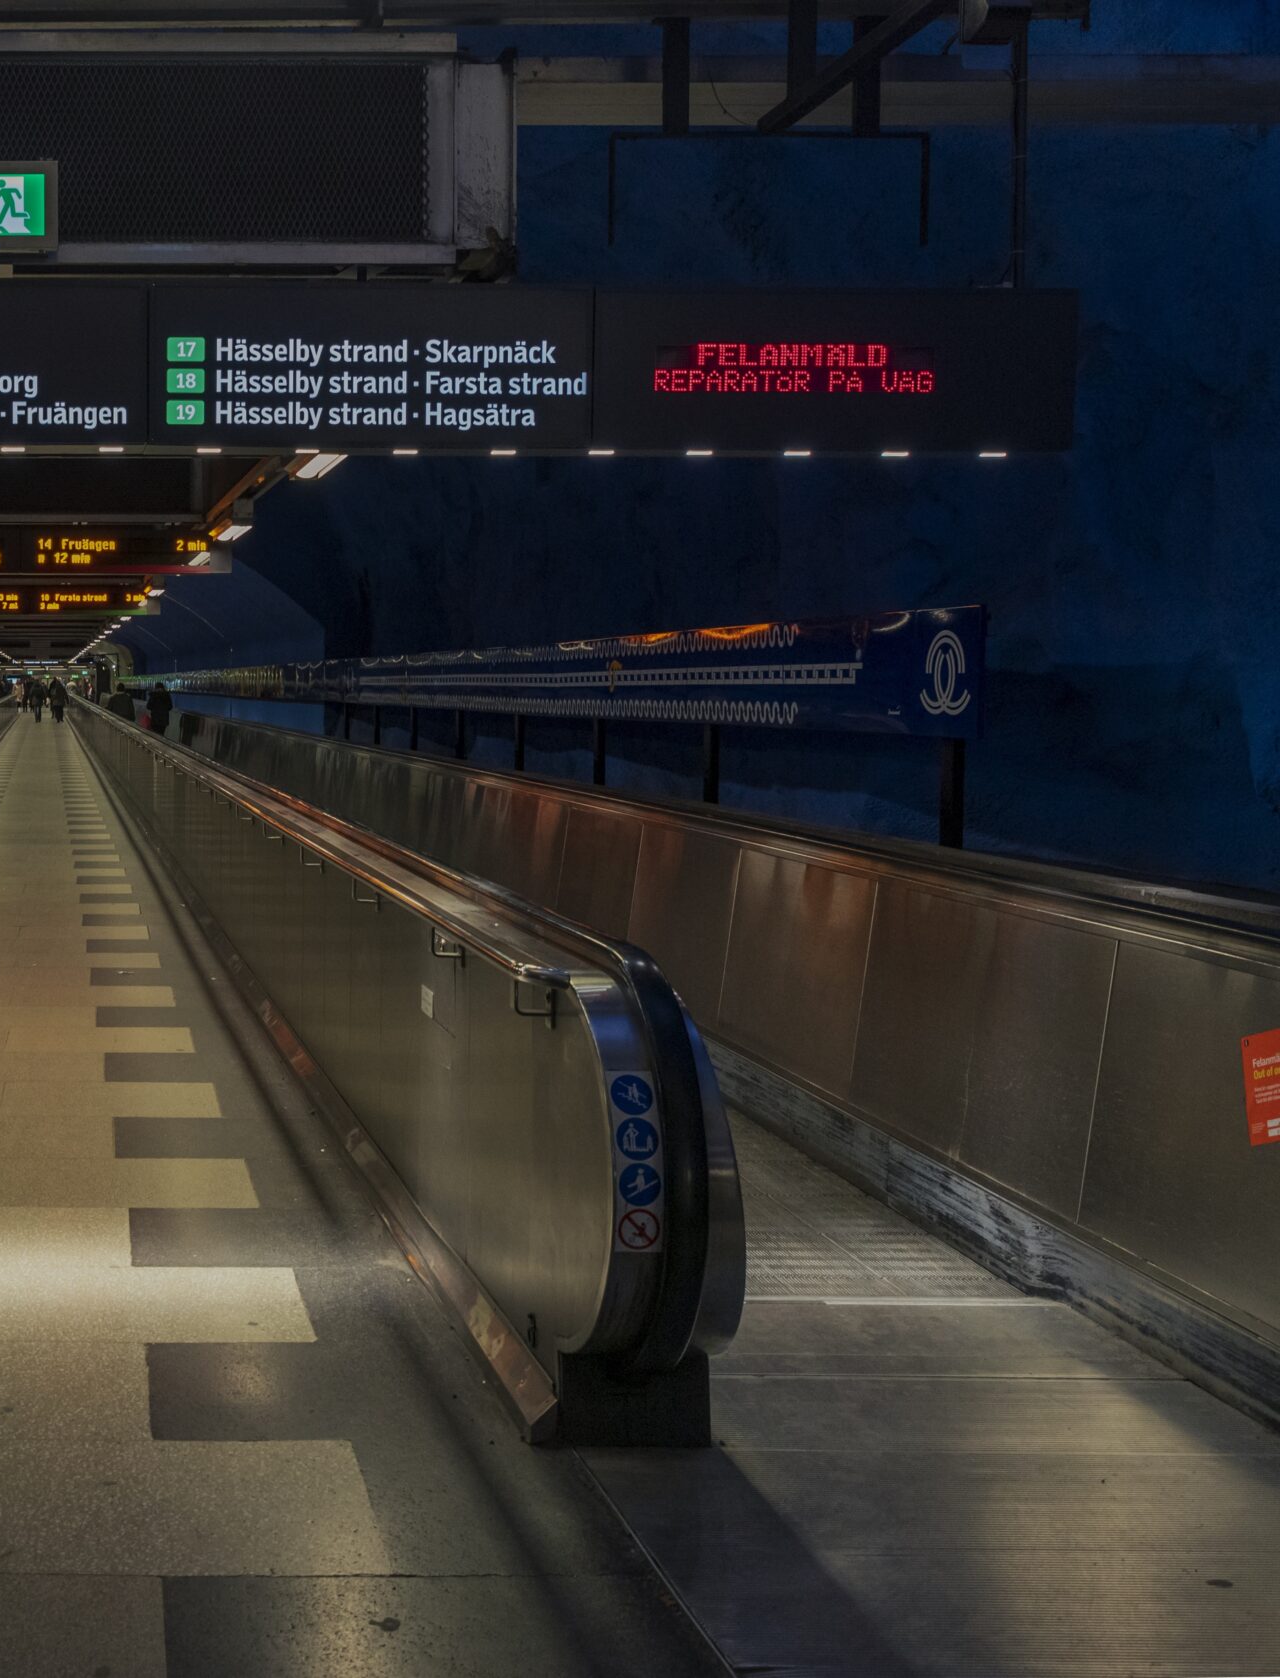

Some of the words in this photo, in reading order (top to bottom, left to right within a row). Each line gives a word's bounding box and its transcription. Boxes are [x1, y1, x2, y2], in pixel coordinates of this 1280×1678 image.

[177, 341, 196, 358] 17
[216, 338, 324, 368] Hässelby
[329, 339, 408, 363] strand
[425, 339, 557, 369] Skarpnäck
[697, 343, 888, 367] FELANMÄLD
[176, 373, 196, 389] 18
[216, 370, 324, 399] Hässelby
[329, 371, 408, 394] strand
[426, 370, 503, 394] Farsta
[508, 371, 588, 395] strand
[654, 369, 811, 393] REPARATÖR
[829, 370, 864, 393] PÅ
[881, 370, 933, 393] VÄG
[11, 401, 128, 430] Fruängen
[176, 404, 196, 421] 19
[215, 401, 323, 430] Hässelby
[329, 402, 407, 425] strand
[425, 402, 536, 431] Hagsätra
[38, 538, 52, 550] 14
[61, 538, 116, 552] Fruängen
[176, 539, 184, 551] 2
[187, 539, 207, 552] min
[54, 553, 68, 564] 12
[71, 553, 92, 565] min
